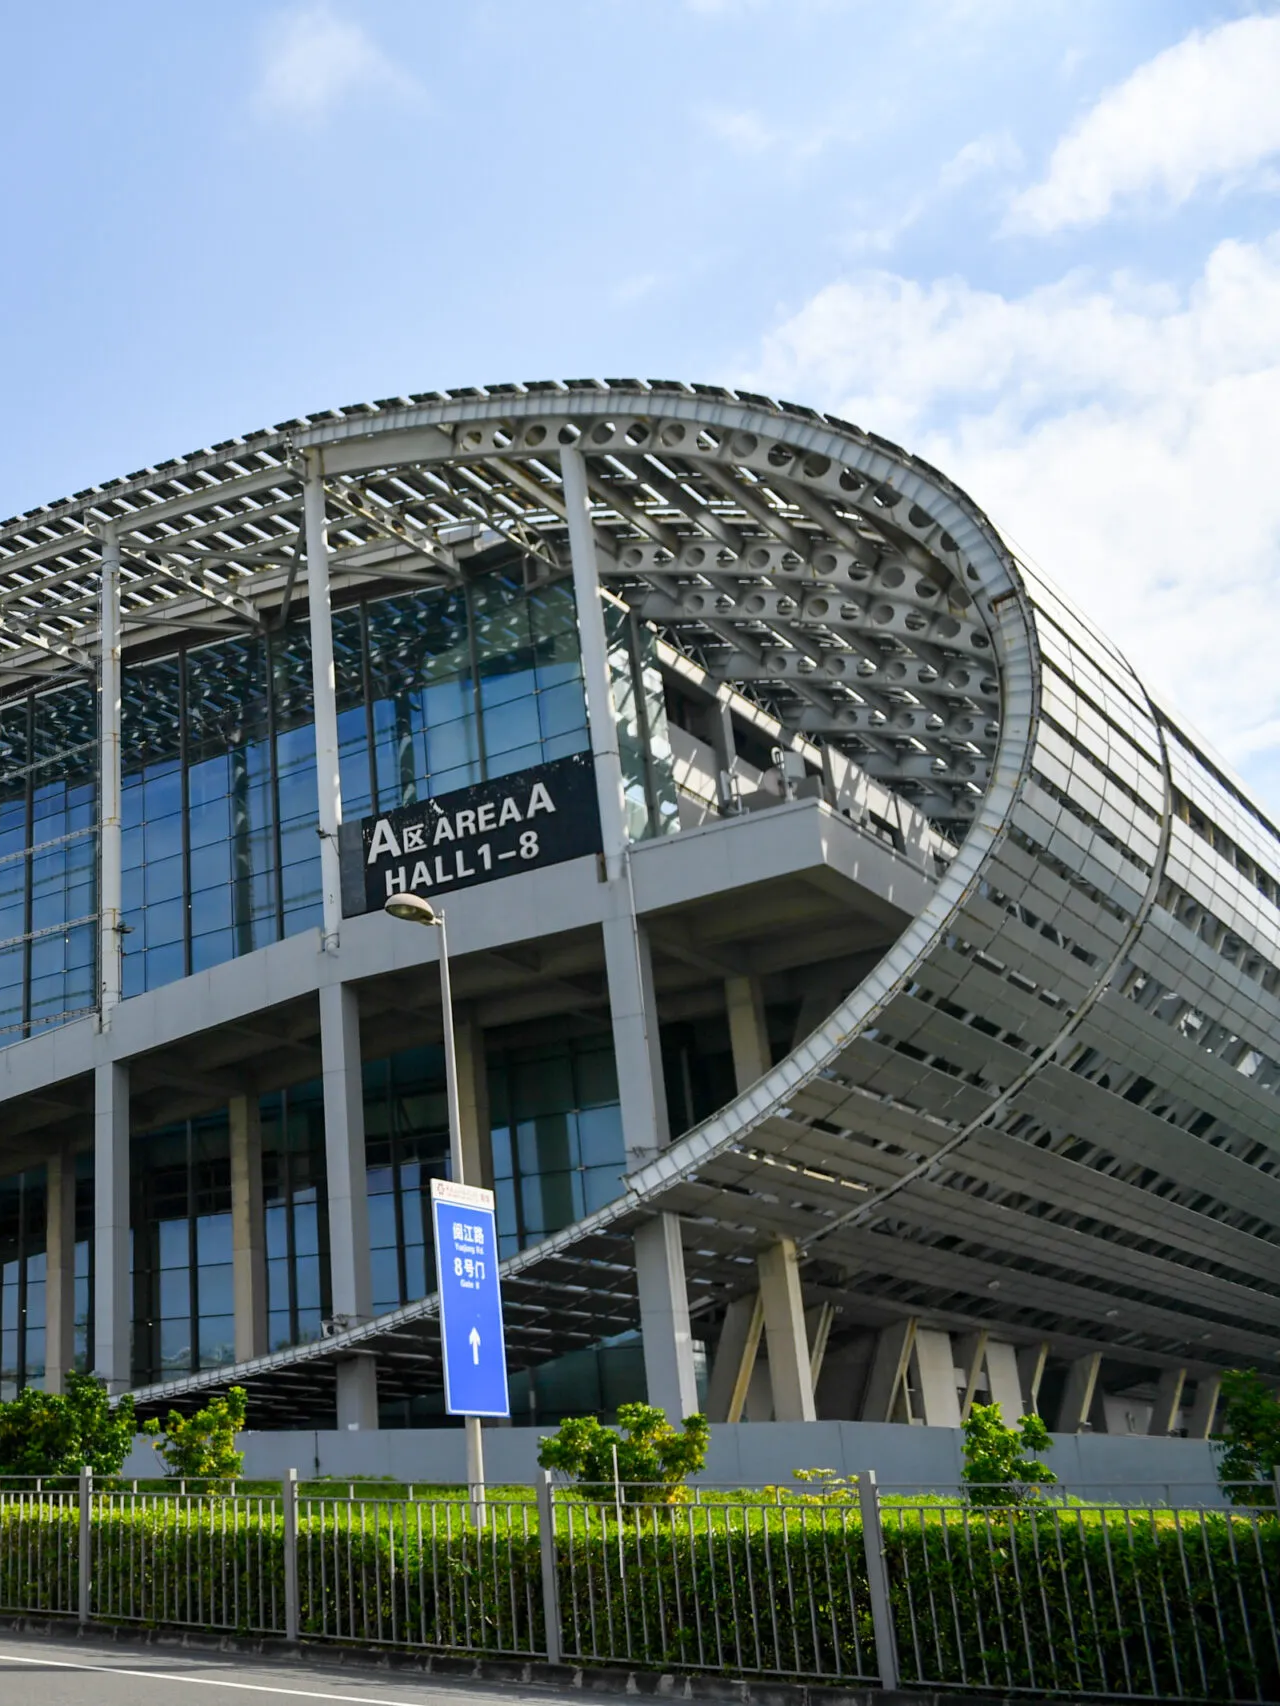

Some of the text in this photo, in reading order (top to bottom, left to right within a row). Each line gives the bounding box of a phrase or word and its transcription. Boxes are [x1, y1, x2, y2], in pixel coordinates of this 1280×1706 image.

[433, 797, 522, 845] AREA
[526, 782, 557, 819] A
[385, 850, 475, 896] HALL
[454, 1257, 485, 1280] 8号门
